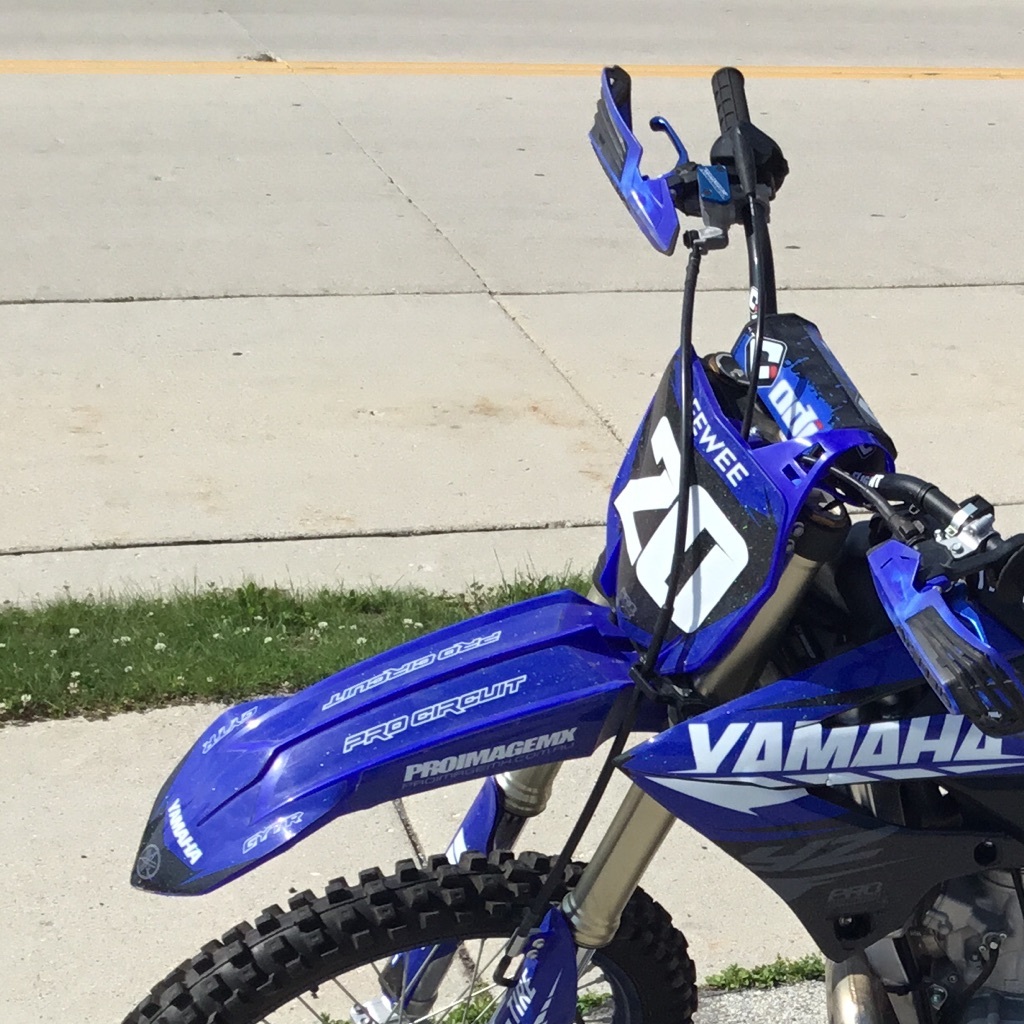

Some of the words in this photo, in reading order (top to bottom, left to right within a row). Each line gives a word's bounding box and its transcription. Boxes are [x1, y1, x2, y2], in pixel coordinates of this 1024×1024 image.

[438, 630, 502, 661] PRO
[322, 653, 436, 711] CIRCUIT
[343, 714, 407, 754] PRO
[409, 674, 527, 732] CIRCUIT
[404, 726, 577, 782] PROIMAGEMX
[165, 797, 203, 866] YAMAHA
